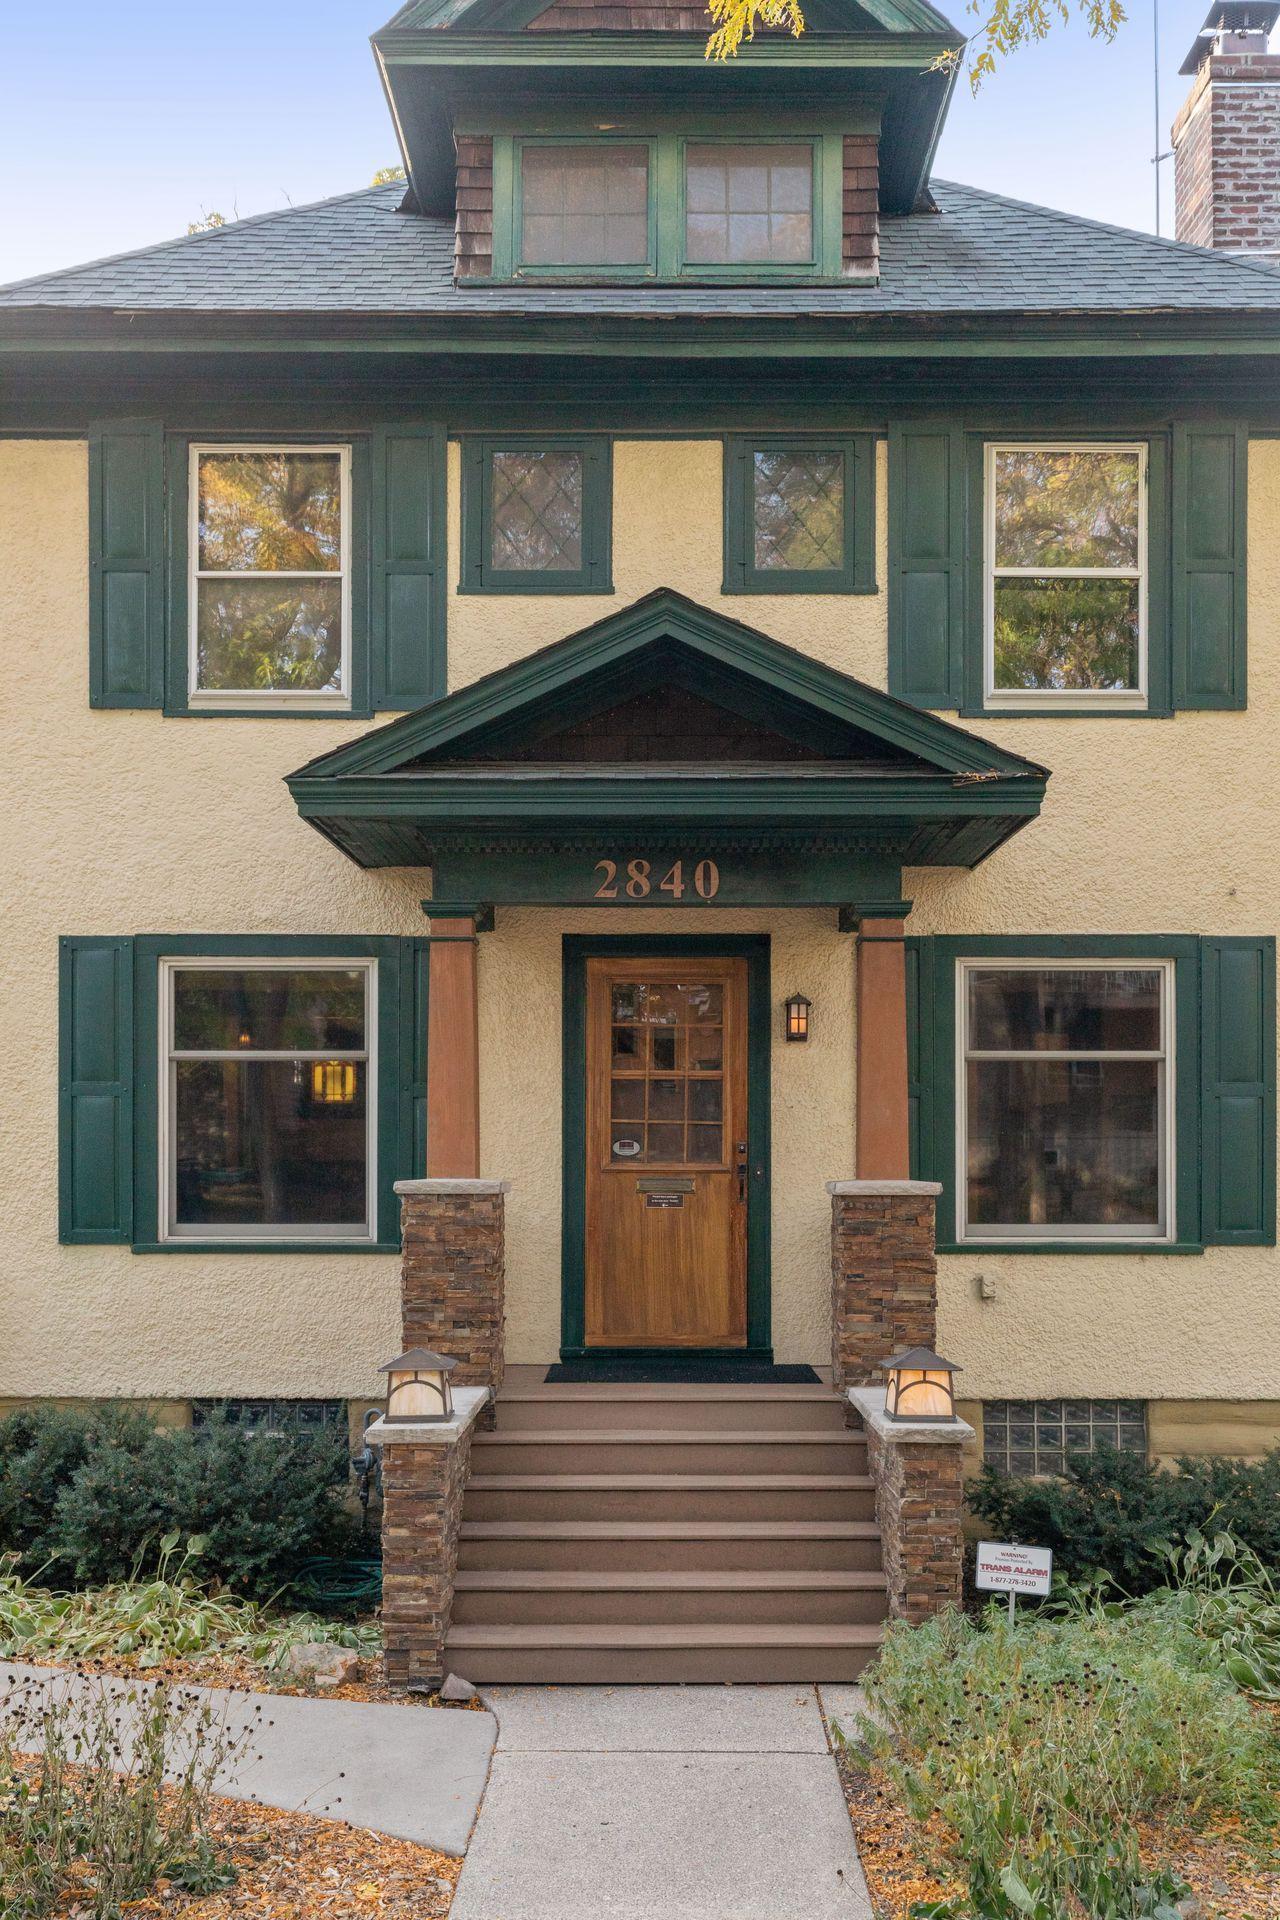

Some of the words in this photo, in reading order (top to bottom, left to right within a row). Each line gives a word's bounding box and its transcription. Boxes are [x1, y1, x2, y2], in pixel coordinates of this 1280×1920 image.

[593, 859, 720, 899] 2840
[980, 1563, 1012, 1572] TRANS
[1014, 1566, 1048, 1576] ALARM
